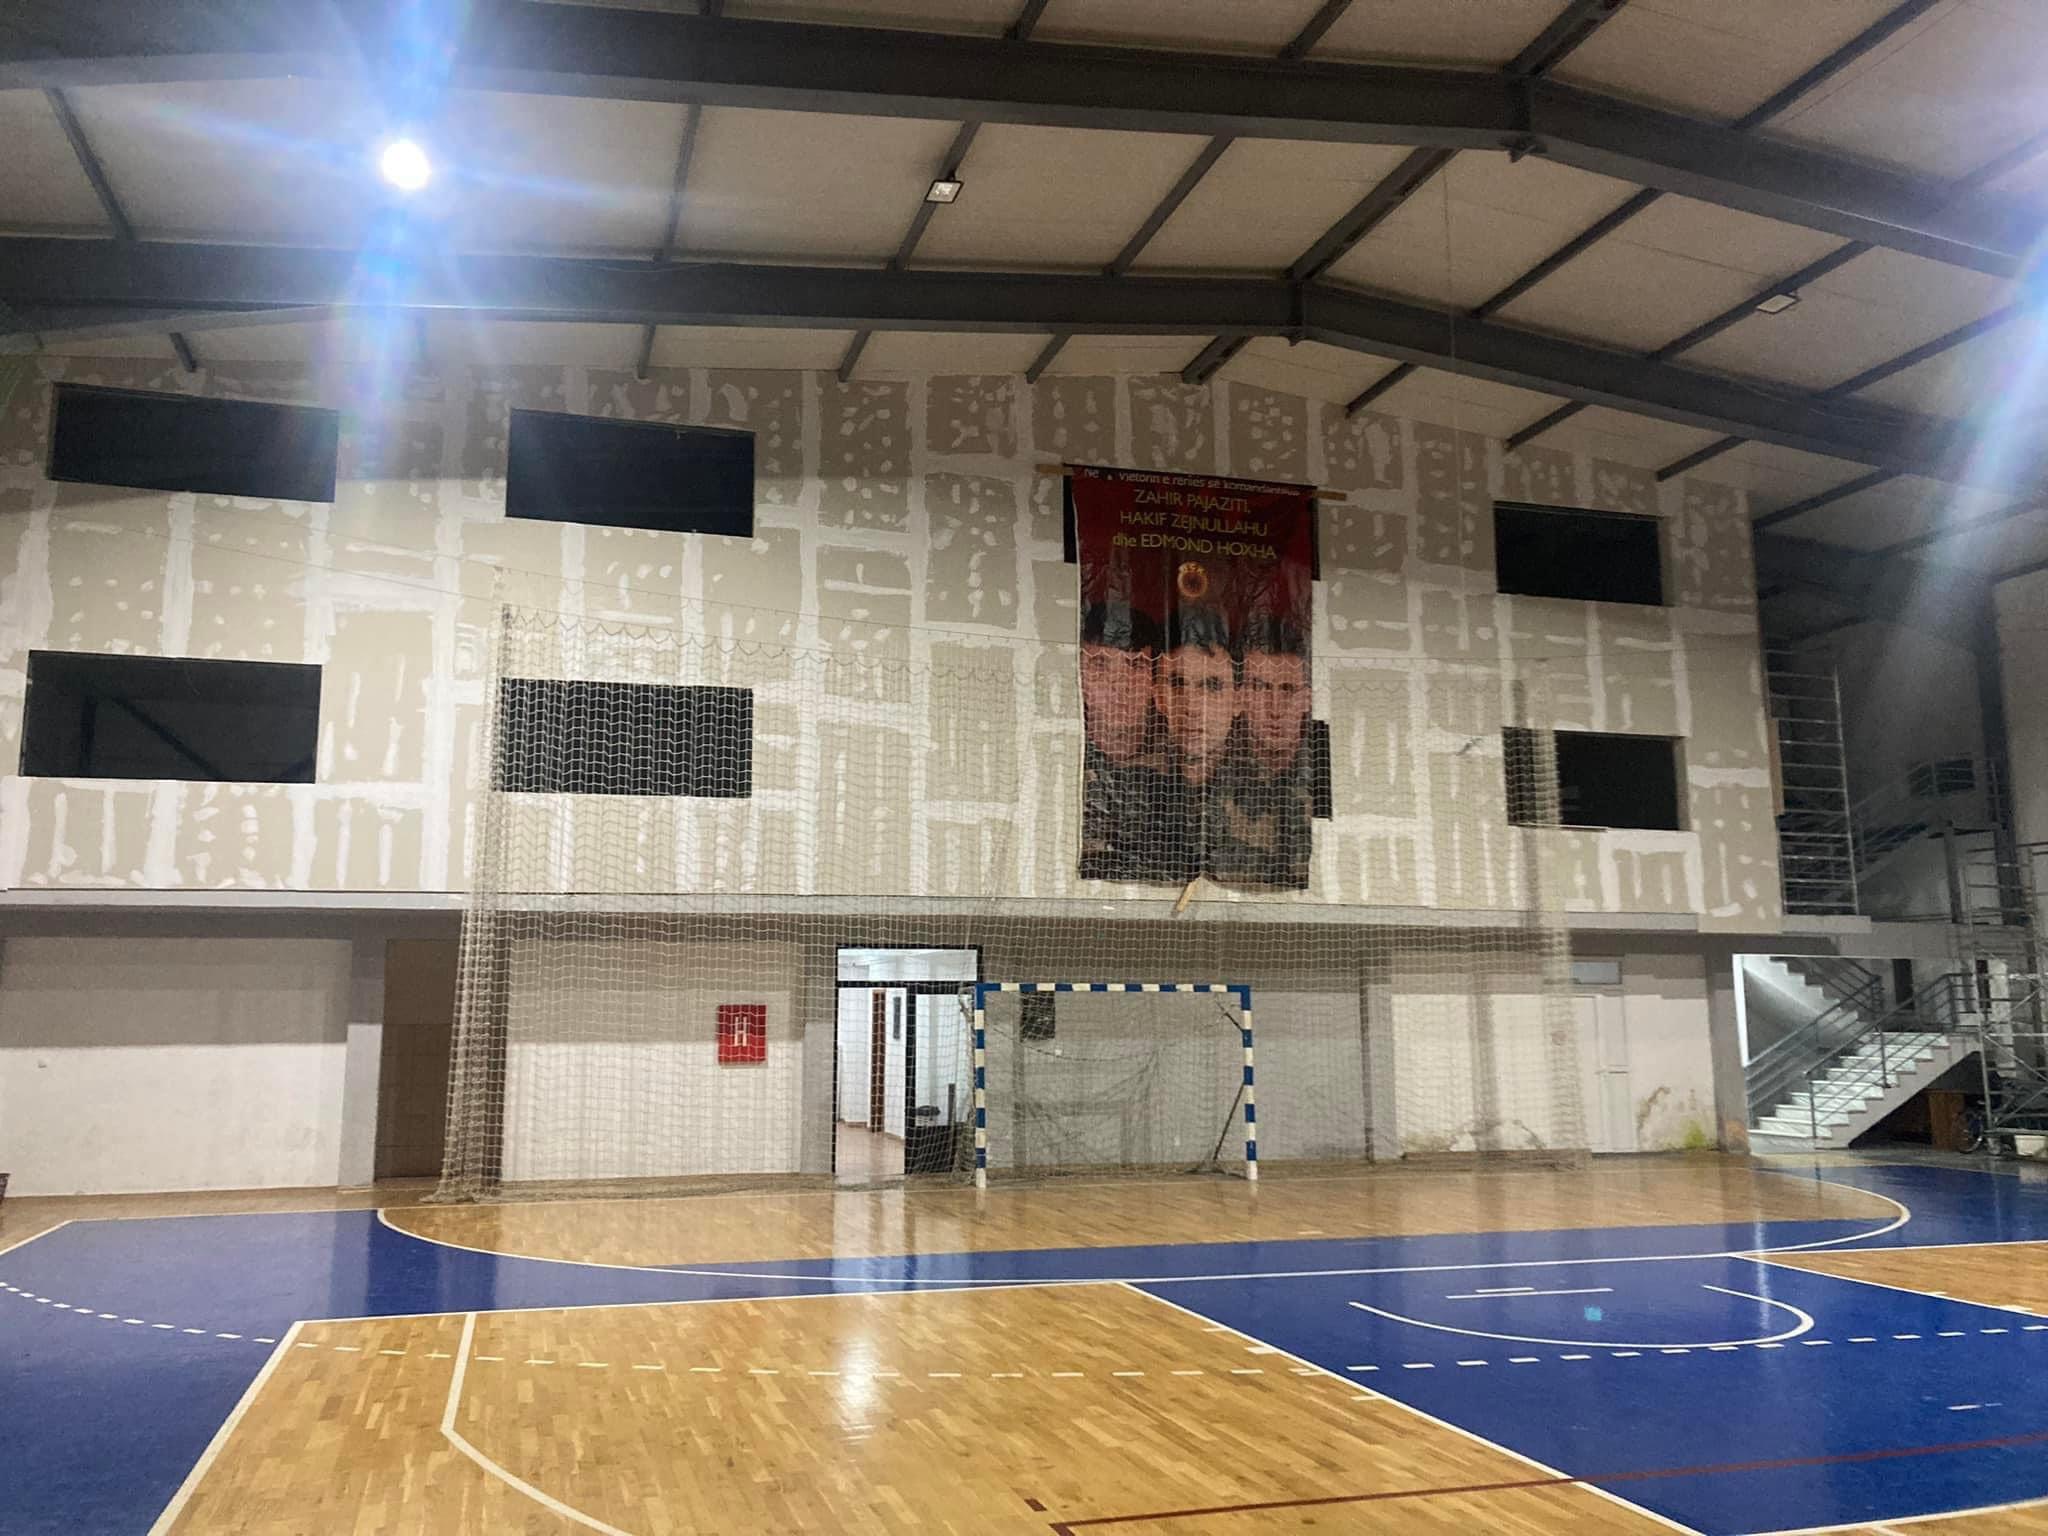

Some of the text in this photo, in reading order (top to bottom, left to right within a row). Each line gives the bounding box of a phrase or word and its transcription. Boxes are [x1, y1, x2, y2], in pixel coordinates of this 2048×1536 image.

[1133, 489, 1184, 506] ZAHIR
[1119, 511, 1268, 537] HAKIF ZEJNULLAHU
[1112, 532, 1278, 560] dhe EDMOND HOXHA
